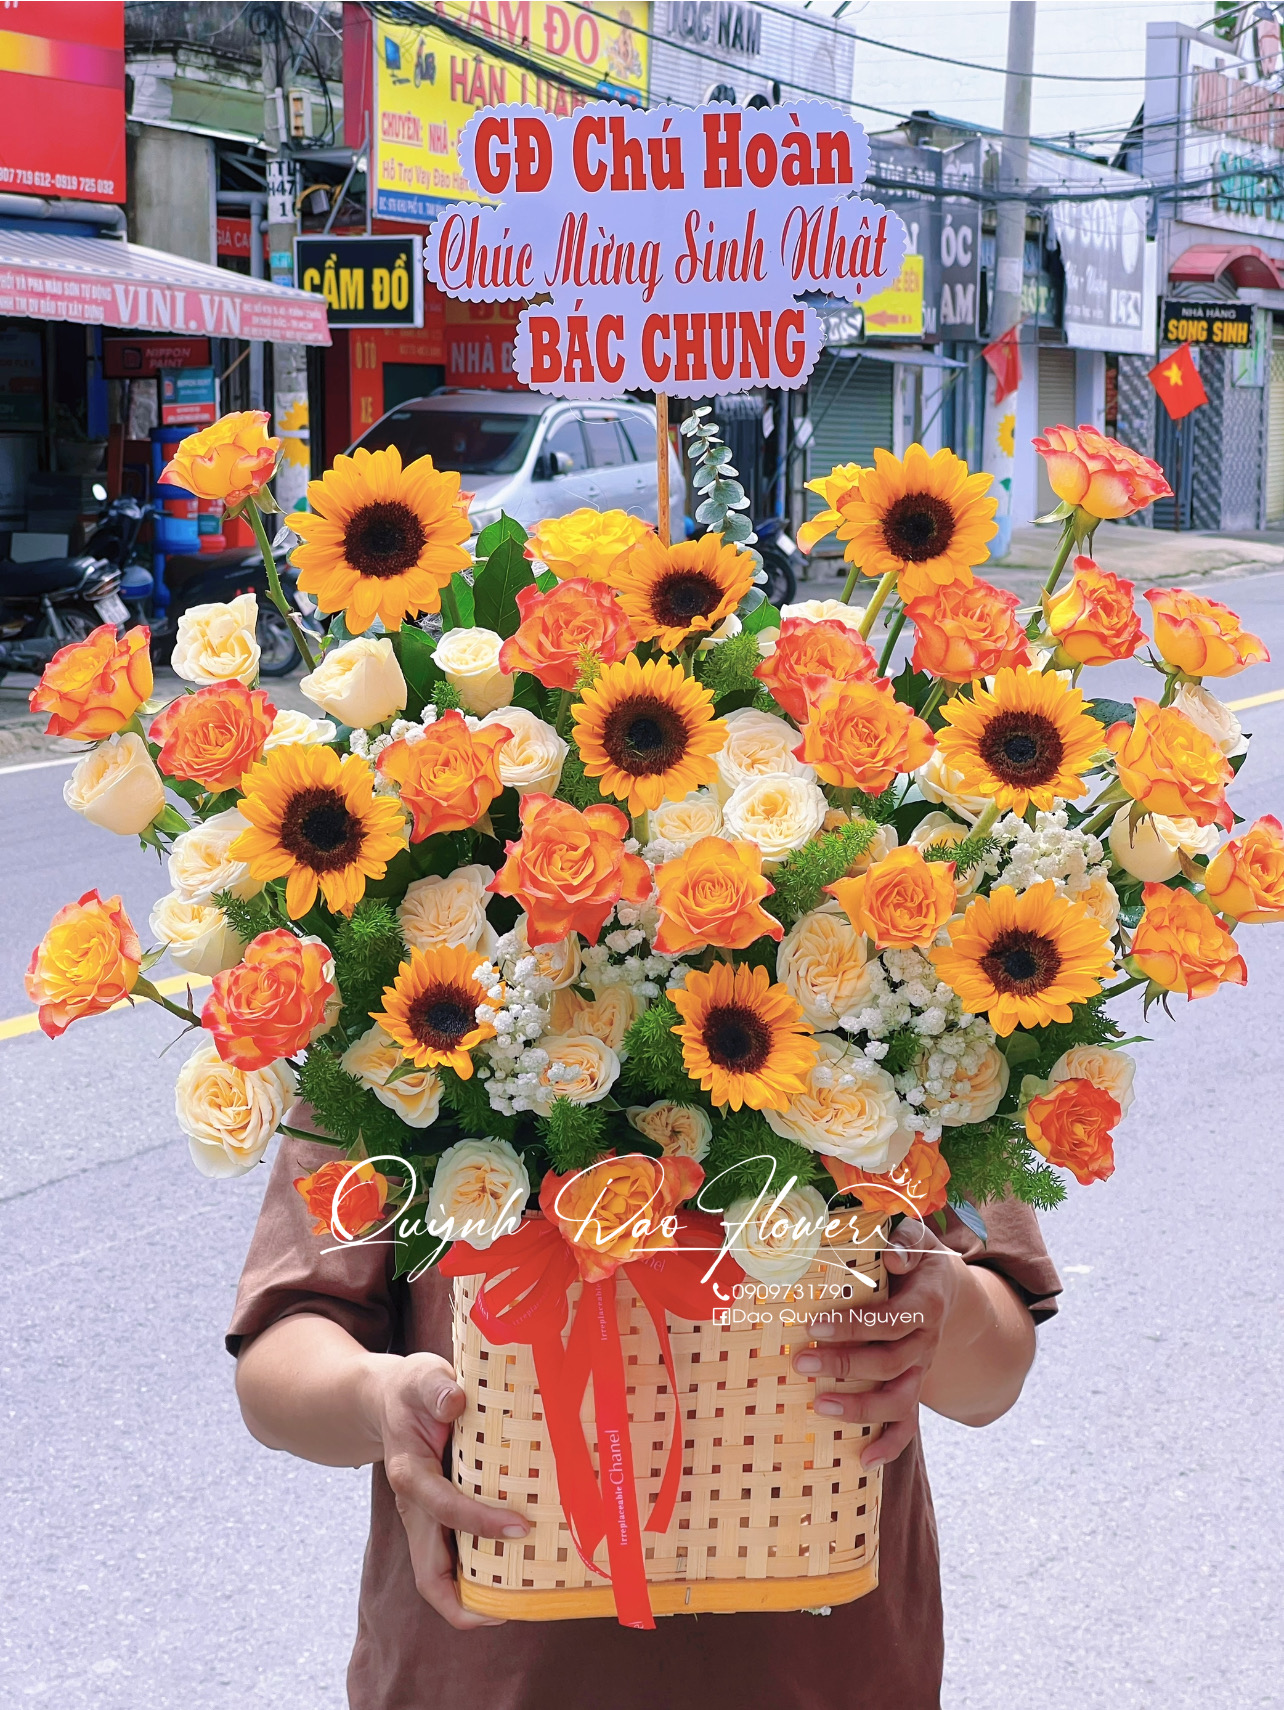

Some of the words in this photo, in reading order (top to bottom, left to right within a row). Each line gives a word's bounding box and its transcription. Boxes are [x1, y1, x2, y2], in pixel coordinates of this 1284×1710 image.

[474, 116, 553, 194] GĐ
[573, 115, 685, 192] Chú
[702, 112, 853, 188] Hoàn
[303, 253, 364, 310] CẦM
[371, 253, 409, 310] ĐỒ
[438, 213, 534, 291] Chúc
[544, 211, 664, 302] Mừng
[674, 208, 768, 284] Sinh
[781, 205, 888, 295] Nhật
[113, 284, 242, 336] VINI.VN
[1167, 319, 1208, 342] SONG
[1212, 320, 1249, 343] SINH
[145, 348, 192, 358] NIPPON
[452, 335, 495, 374] NHÀ
[528, 298, 626, 384] BÁC
[641, 308, 805, 383] CHUNG
[604, 1429, 625, 1486] Chanel
[617, 1485, 628, 1546] Irreplaceable
